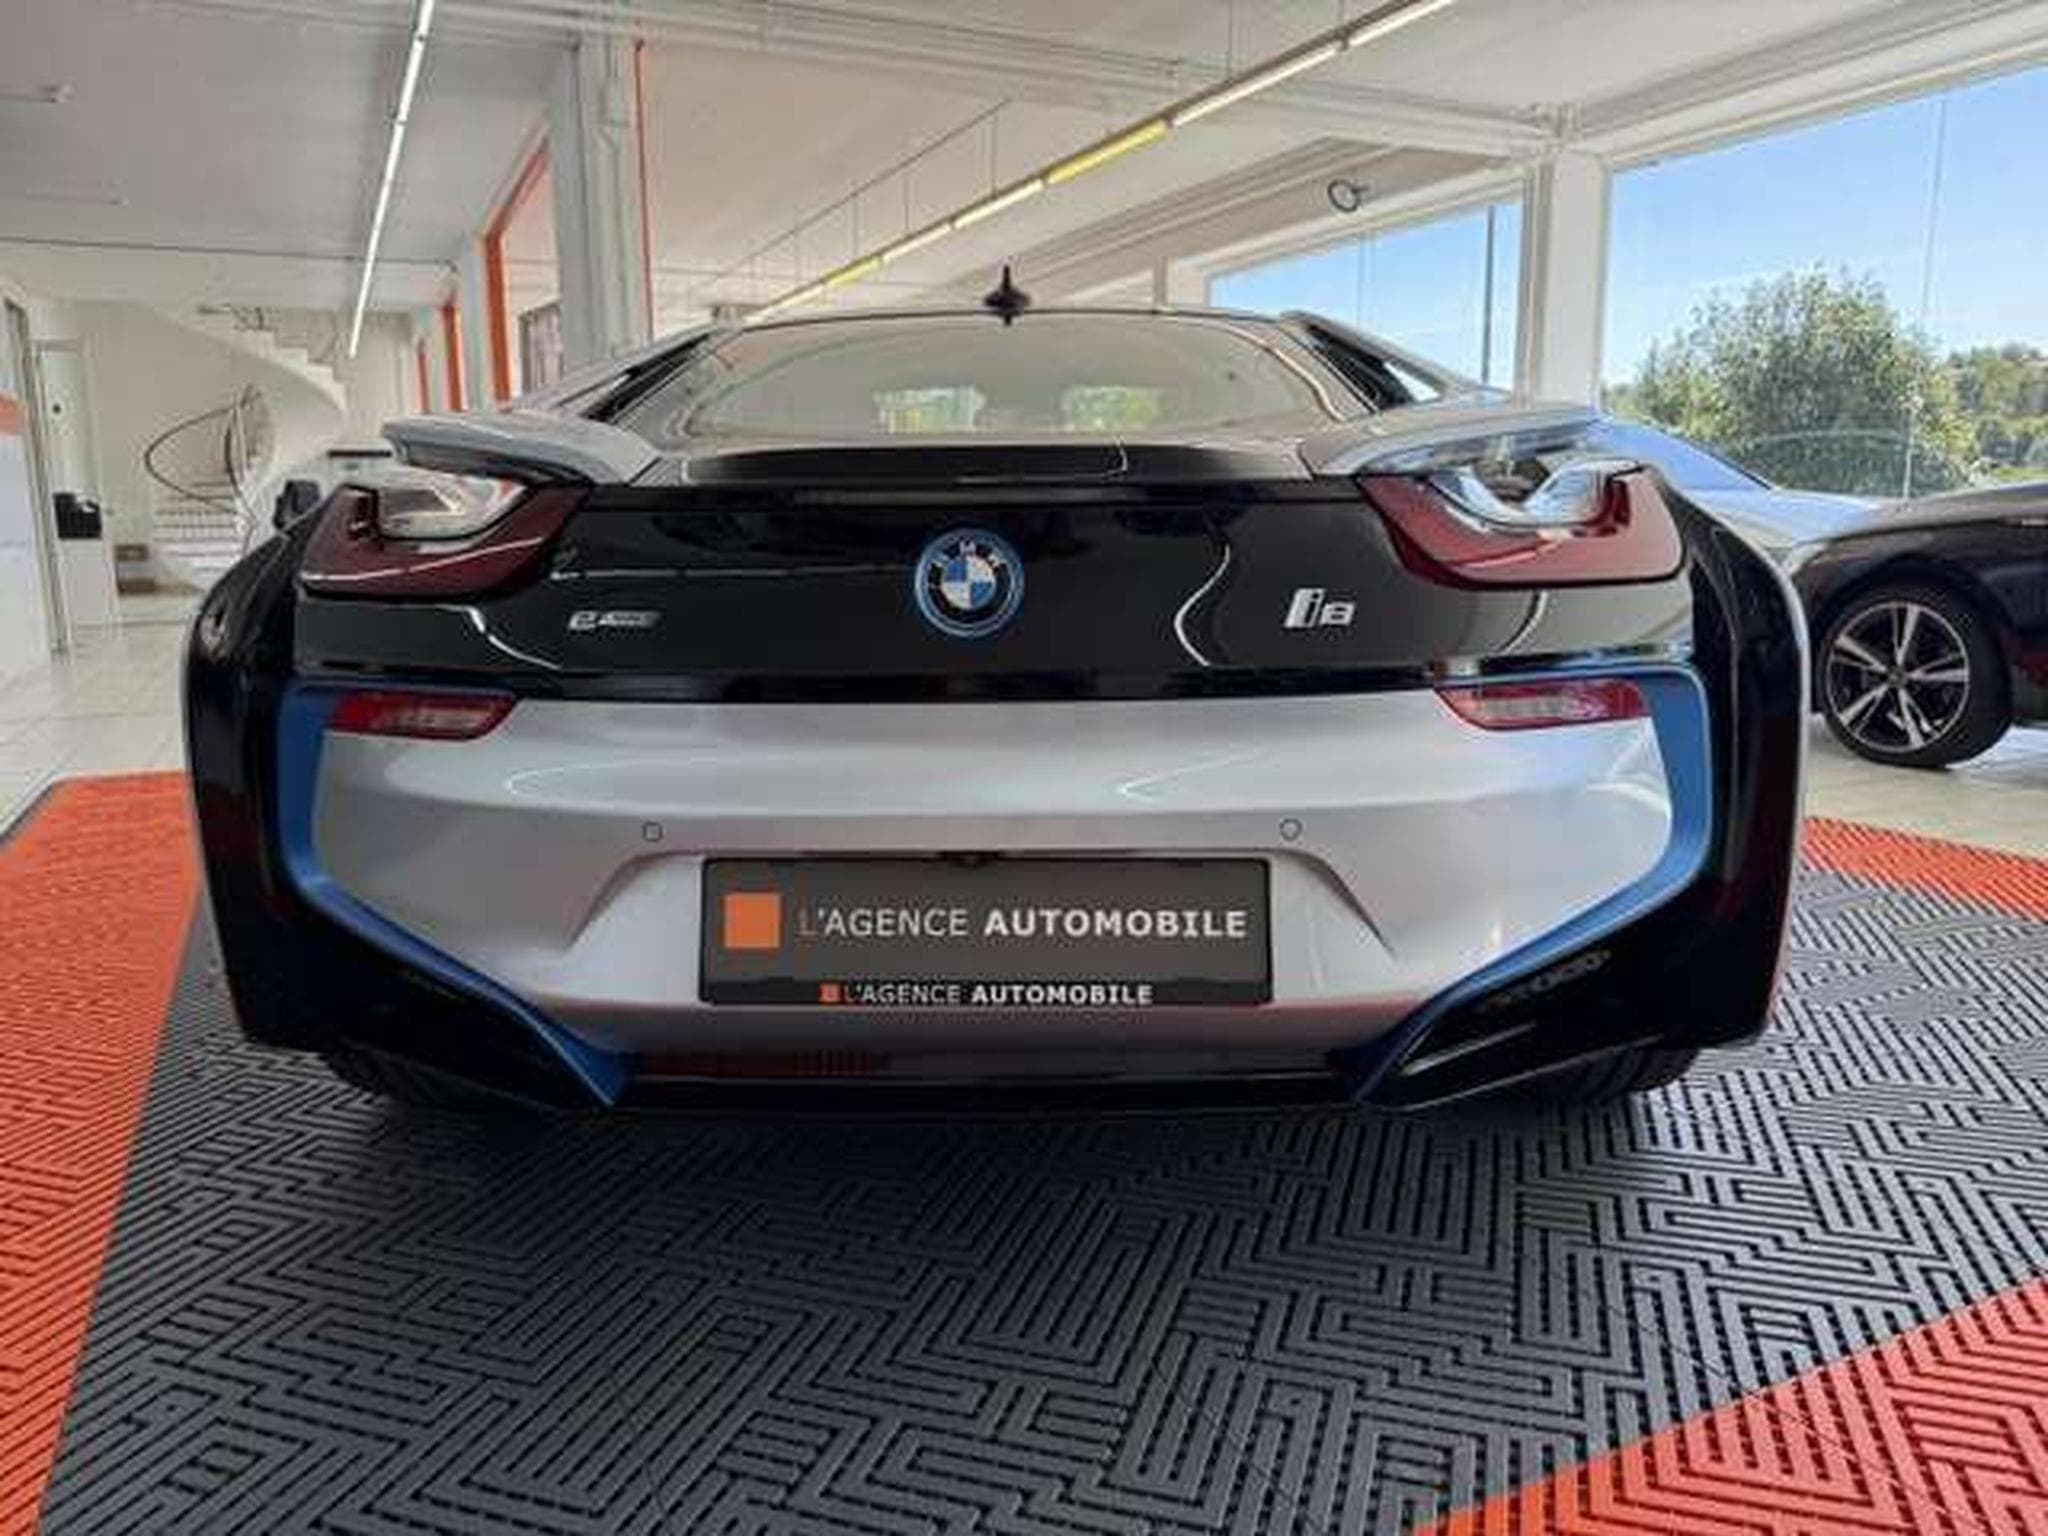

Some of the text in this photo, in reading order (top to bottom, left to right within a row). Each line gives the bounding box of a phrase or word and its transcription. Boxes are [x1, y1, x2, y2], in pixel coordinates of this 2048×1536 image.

[797, 908, 1247, 938] L'AGENCE AUTOMOBILE
[843, 983, 1153, 1005] L'AGENCE AUTOMOBILE
